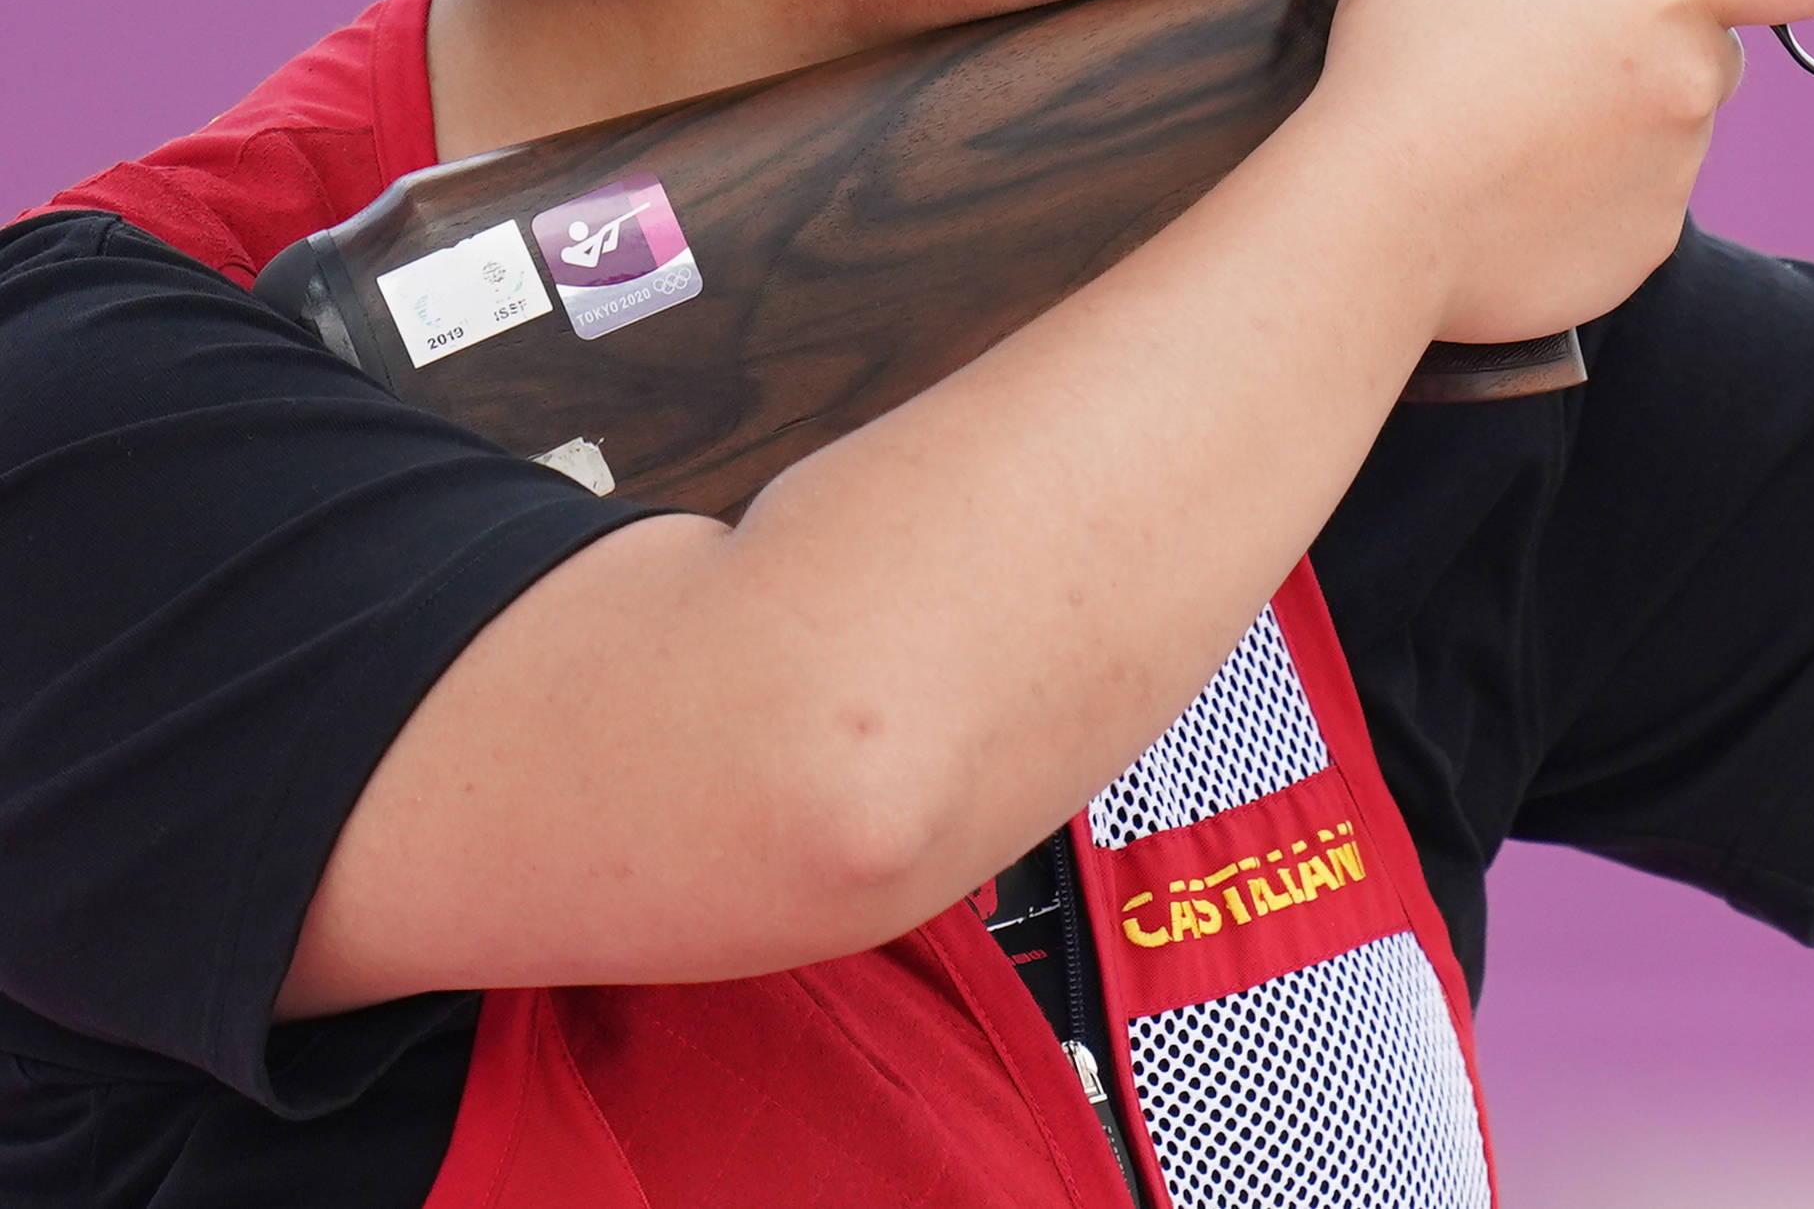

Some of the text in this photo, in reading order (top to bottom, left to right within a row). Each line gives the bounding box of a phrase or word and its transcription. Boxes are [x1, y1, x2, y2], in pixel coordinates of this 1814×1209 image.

[576, 288, 652, 327] TOKYO 2020
[427, 327, 464, 350] 2019
